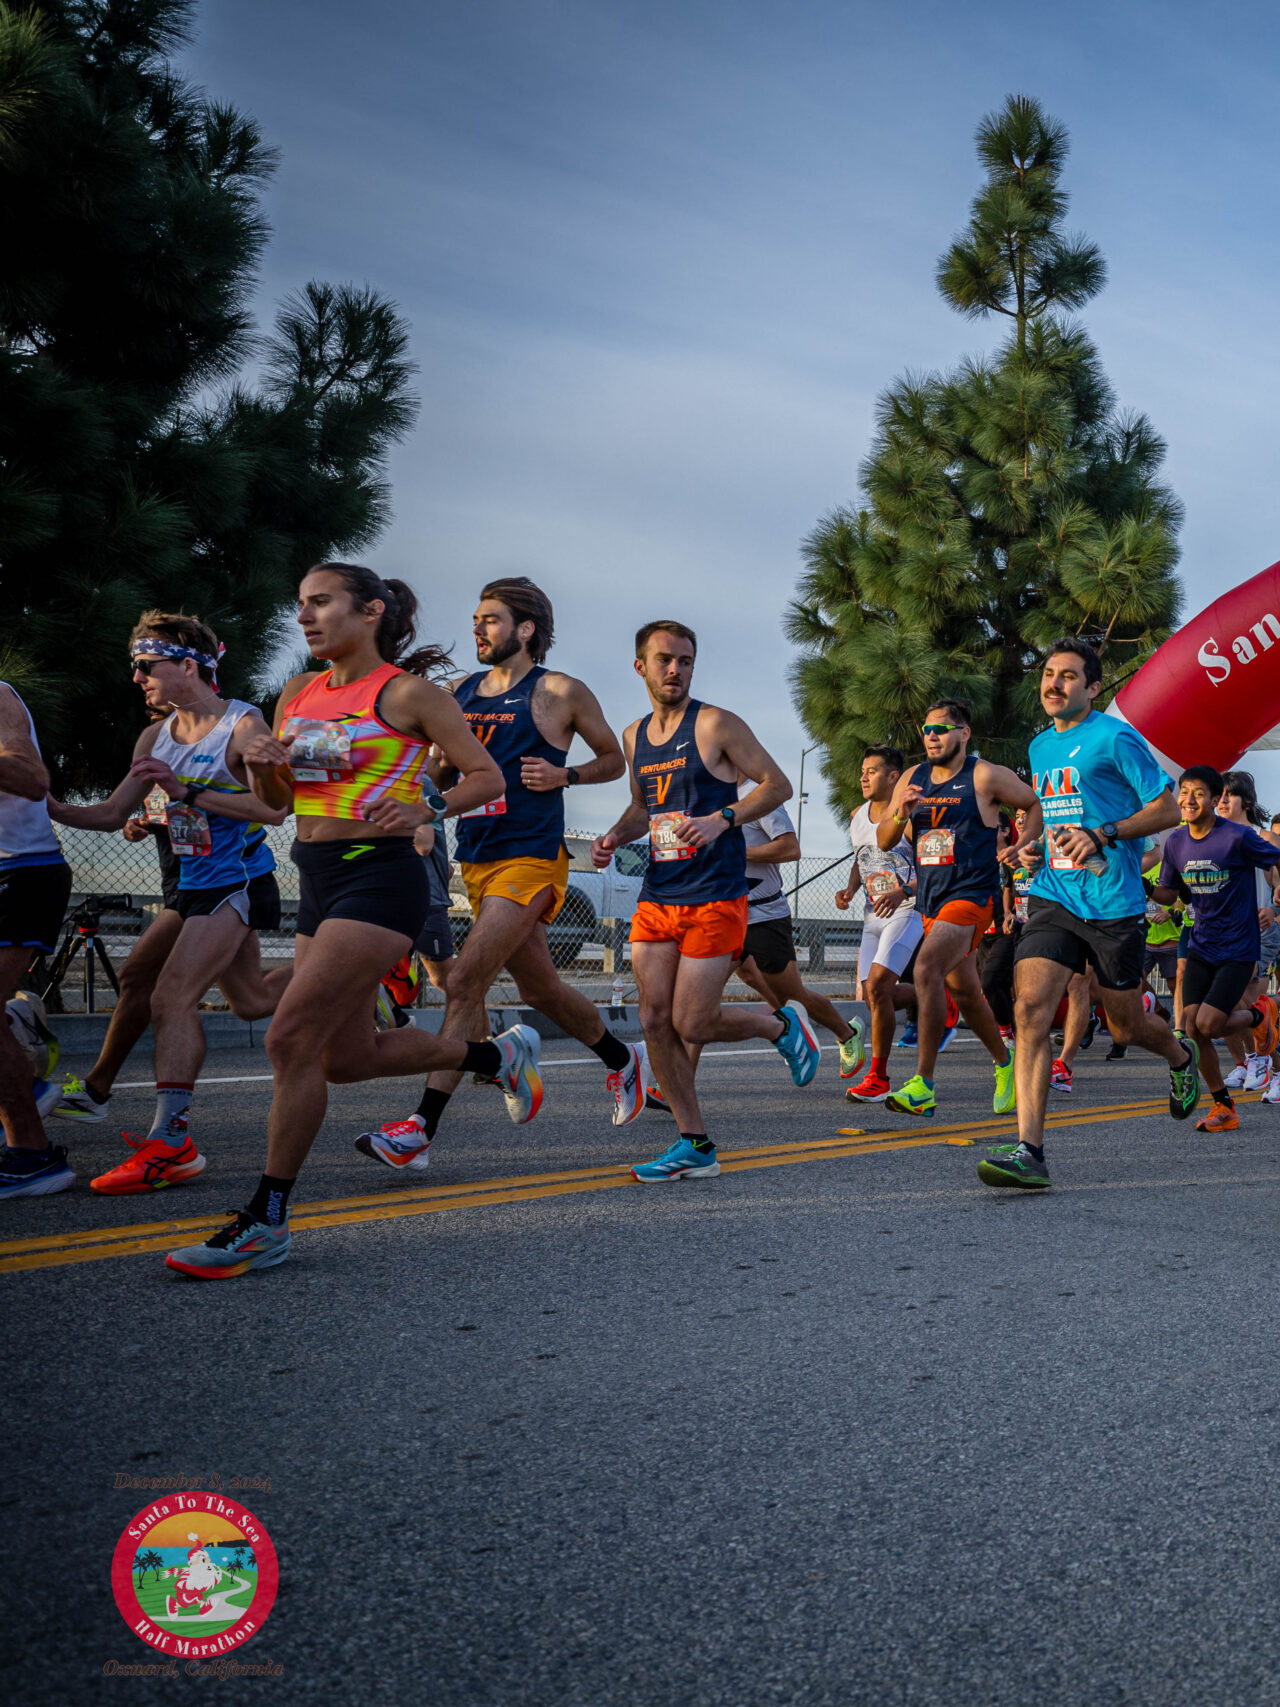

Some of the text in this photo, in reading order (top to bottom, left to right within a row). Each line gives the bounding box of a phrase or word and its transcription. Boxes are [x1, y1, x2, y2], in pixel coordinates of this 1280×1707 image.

[463, 712, 517, 721] ENTURACERS
[304, 742, 314, 760] 3
[640, 756, 687, 774] VENTURACERS
[918, 797, 962, 805] NTURACERS
[1046, 798, 1083, 809] ANGELES
[1050, 808, 1084, 817] RUNNERS
[171, 825, 189, 838] 577
[1199, 871, 1206, 883] &
[1206, 869, 1230, 883] FIELD
